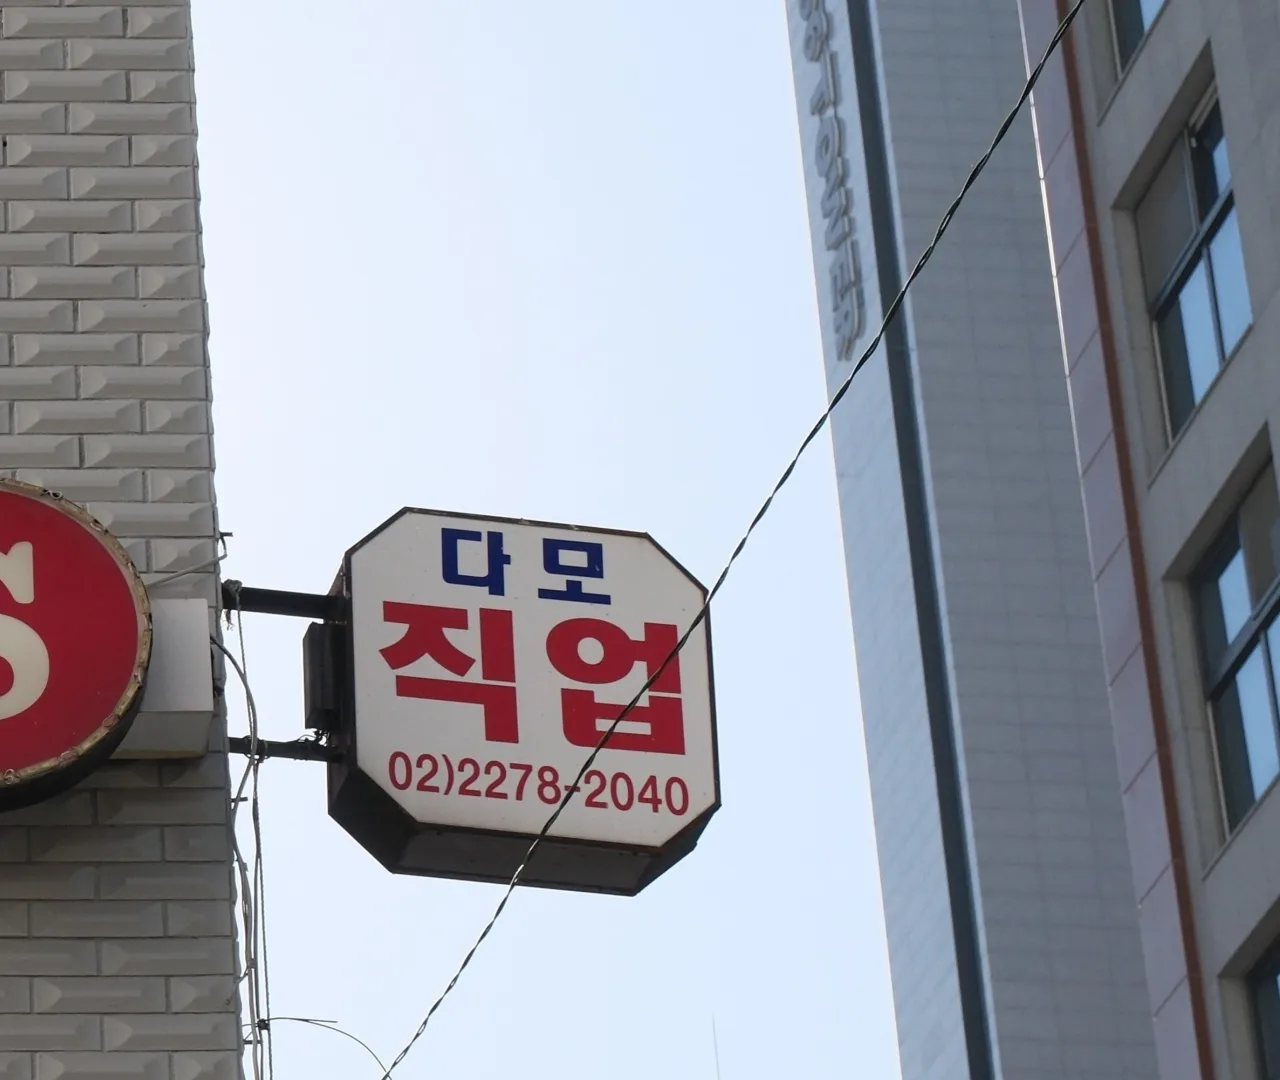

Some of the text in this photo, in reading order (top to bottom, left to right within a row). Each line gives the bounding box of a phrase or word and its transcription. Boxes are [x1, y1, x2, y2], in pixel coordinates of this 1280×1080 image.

[441, 527, 611, 605] 다모
[378, 600, 686, 755] 직업
[388, 751, 690, 816] 02)2278-2040
